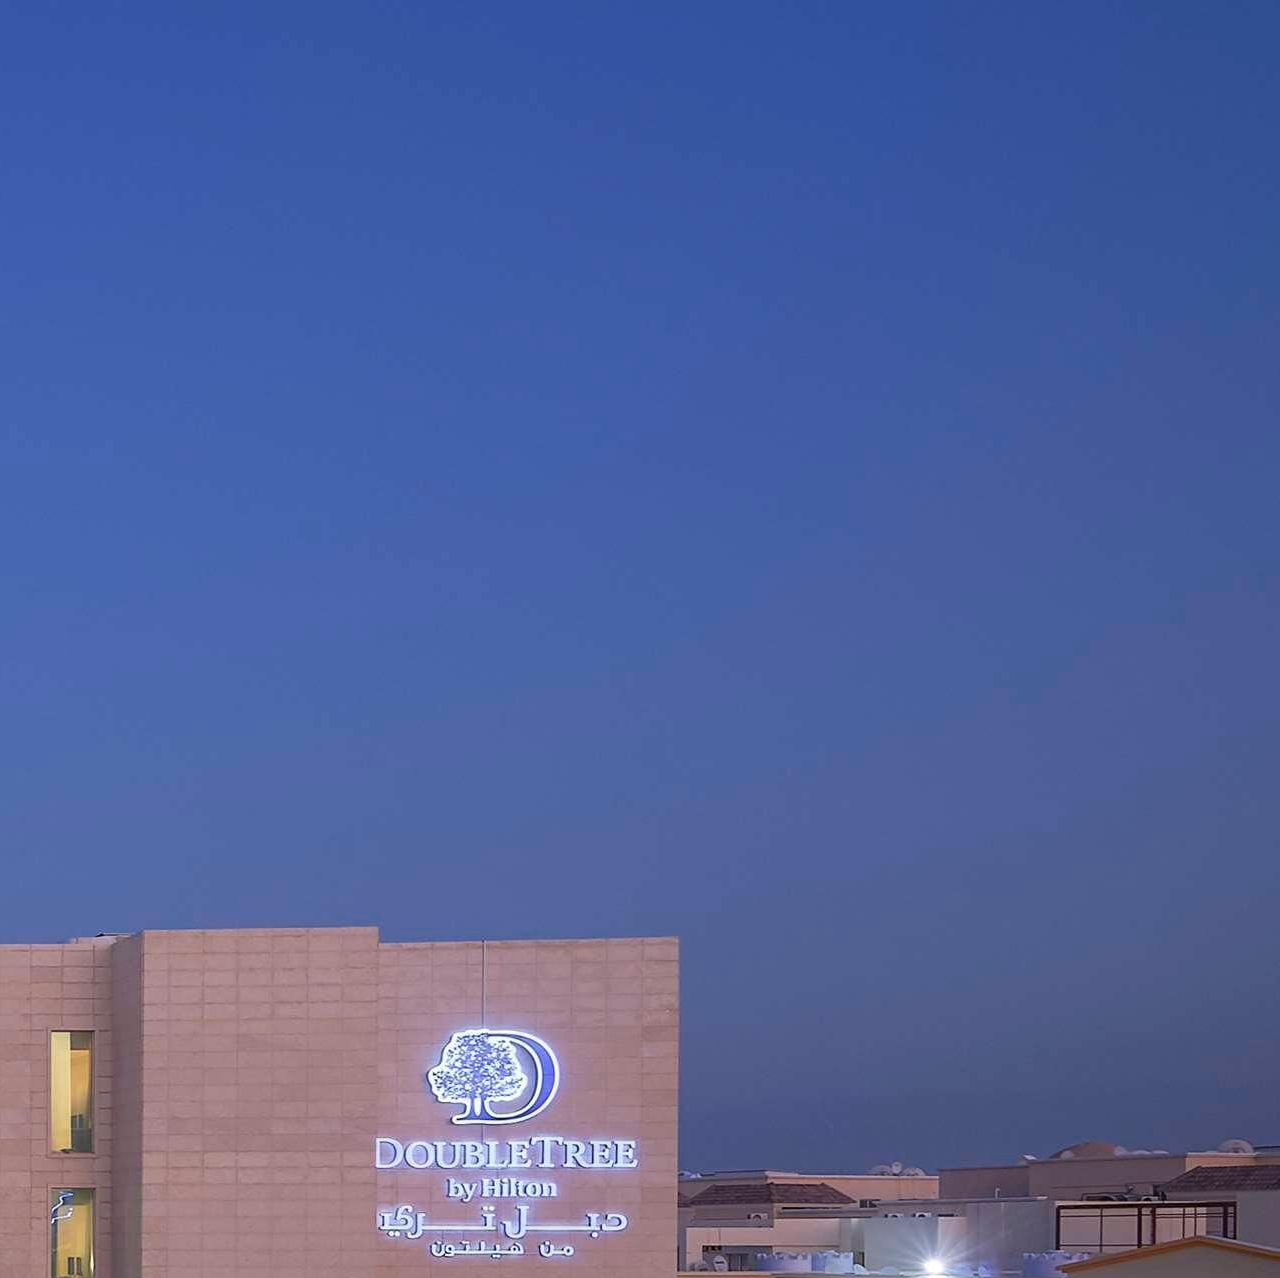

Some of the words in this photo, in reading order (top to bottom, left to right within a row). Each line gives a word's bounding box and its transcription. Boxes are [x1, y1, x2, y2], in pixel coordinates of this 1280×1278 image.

[375, 1137, 638, 1168] DOUBLETREE
[447, 1178, 478, 1202] by
[481, 1177, 558, 1197] Hilton
